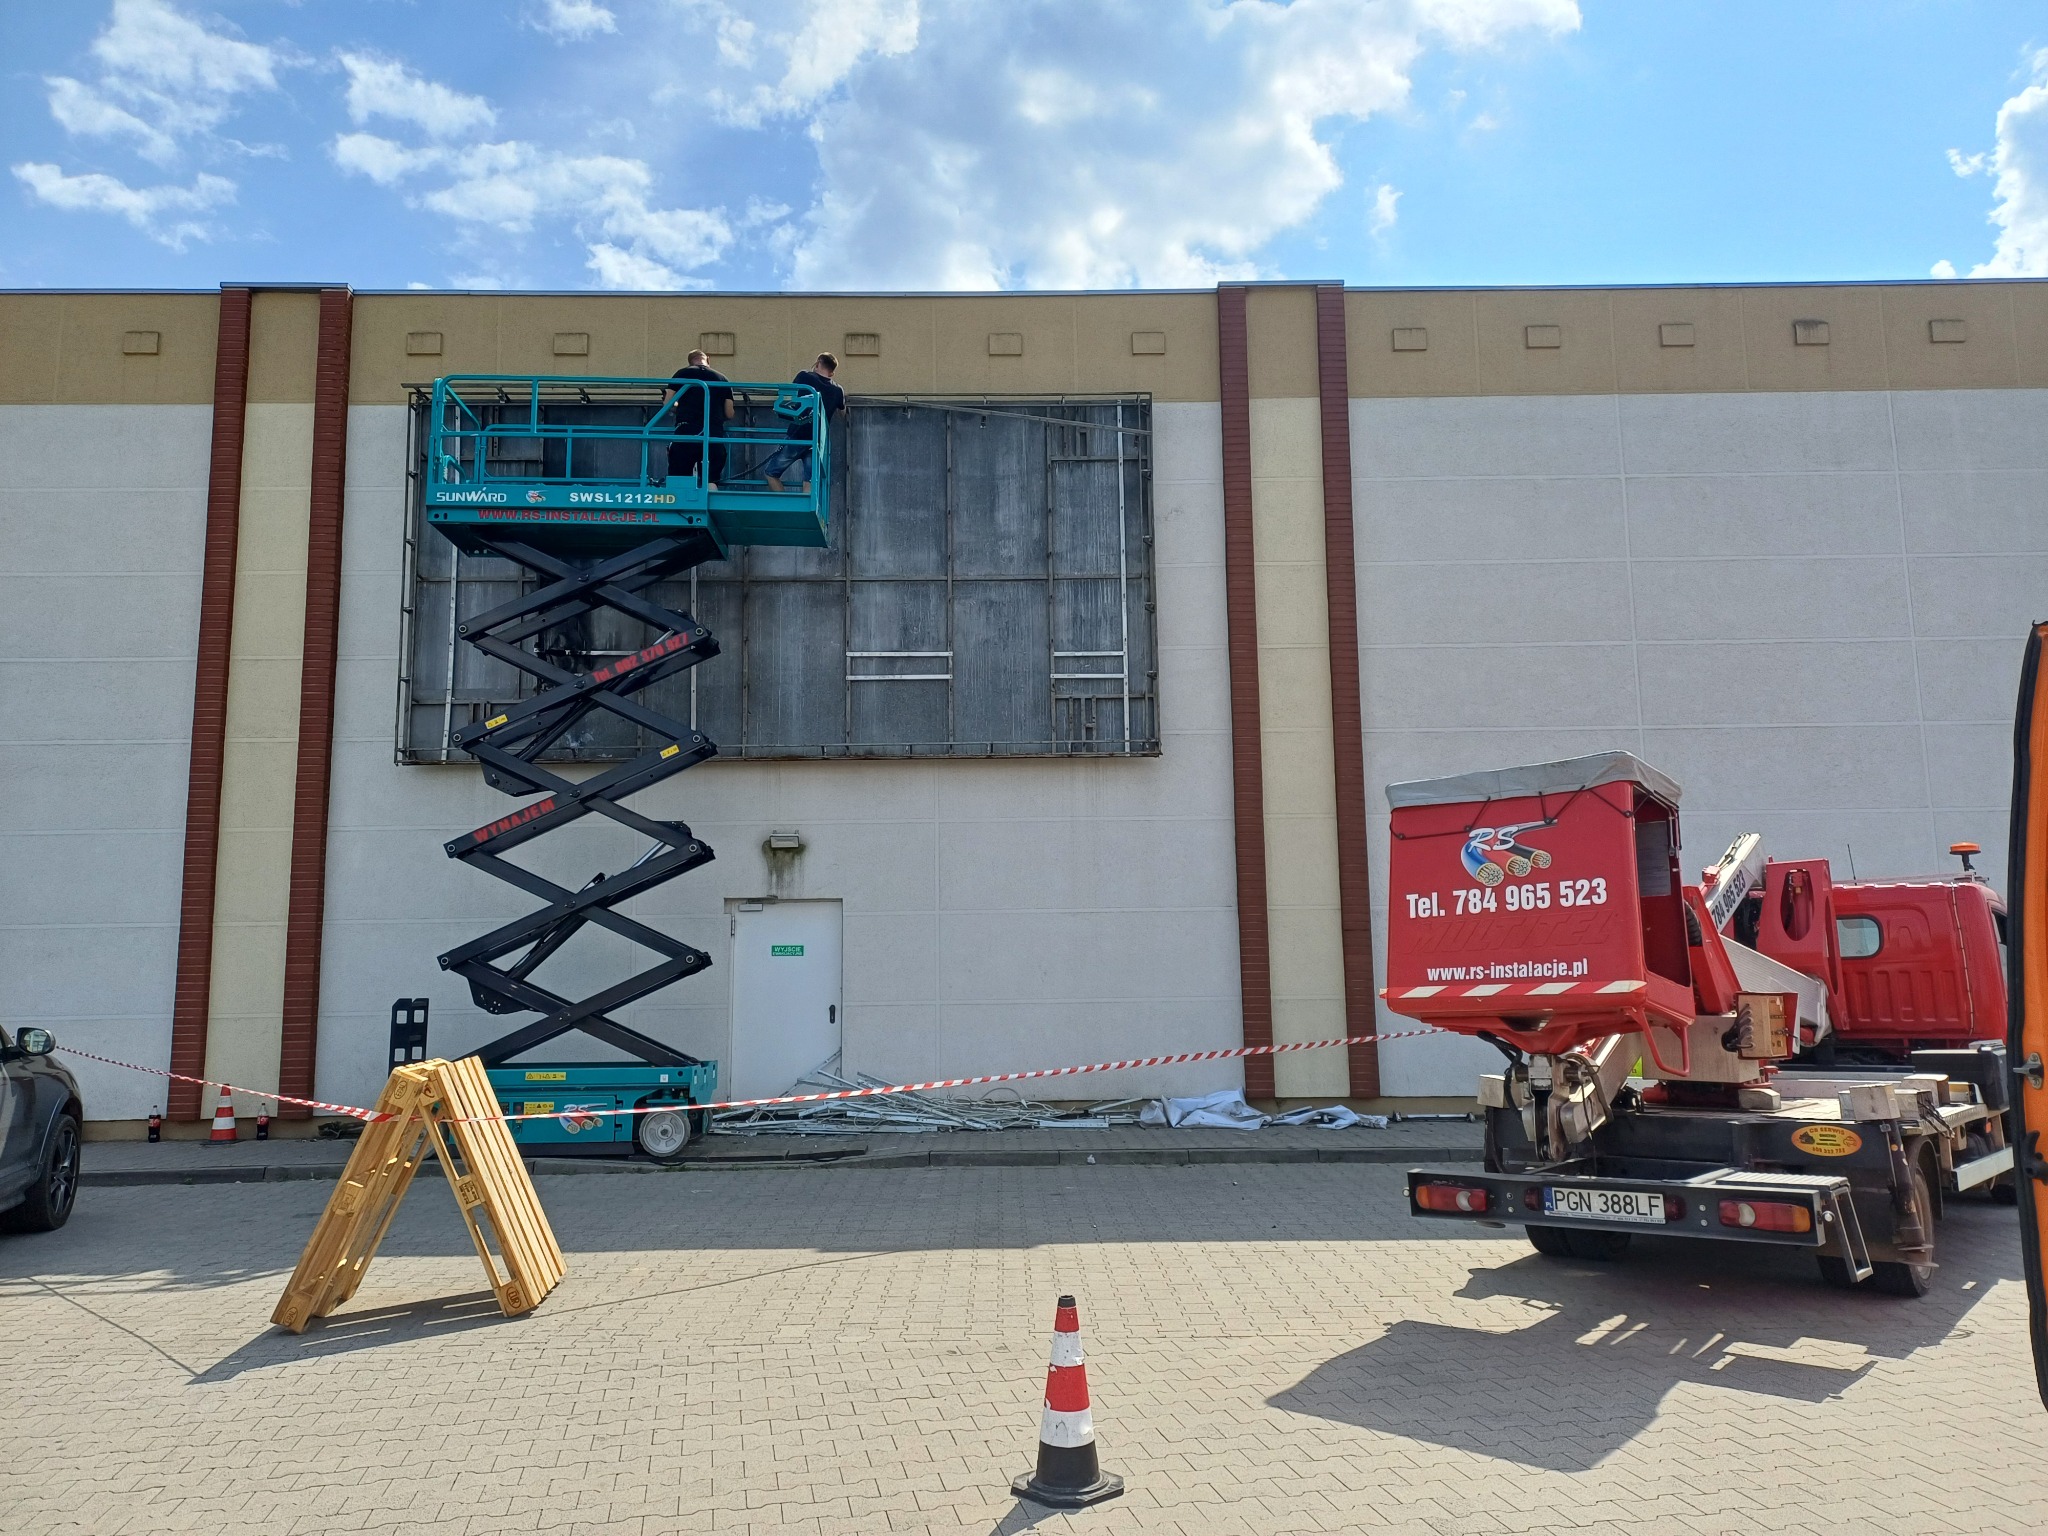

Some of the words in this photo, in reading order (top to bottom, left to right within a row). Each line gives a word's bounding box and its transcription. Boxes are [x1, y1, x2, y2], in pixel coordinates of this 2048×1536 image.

[436, 487, 507, 503] SUNWARD
[569, 492, 676, 504] SWSL1212HD
[477, 509, 660, 523] WWW.RS-INSTALACJE.PL
[473, 798, 555, 843] WYNAJEM
[1468, 826, 1520, 853] RS
[1406, 892, 1446, 919] Tel.
[1452, 887, 1498, 916] 784
[1505, 882, 1551, 911] 965
[1559, 877, 1608, 907] 523
[1712, 901, 1726, 929] 784
[1722, 885, 1736, 913] 965
[1733, 869, 1746, 897] 523
[1427, 958, 1589, 981] www.rs-instalacje.pl
[1553, 1189, 1592, 1212] PGN
[1598, 1193, 1661, 1217] 388LF
